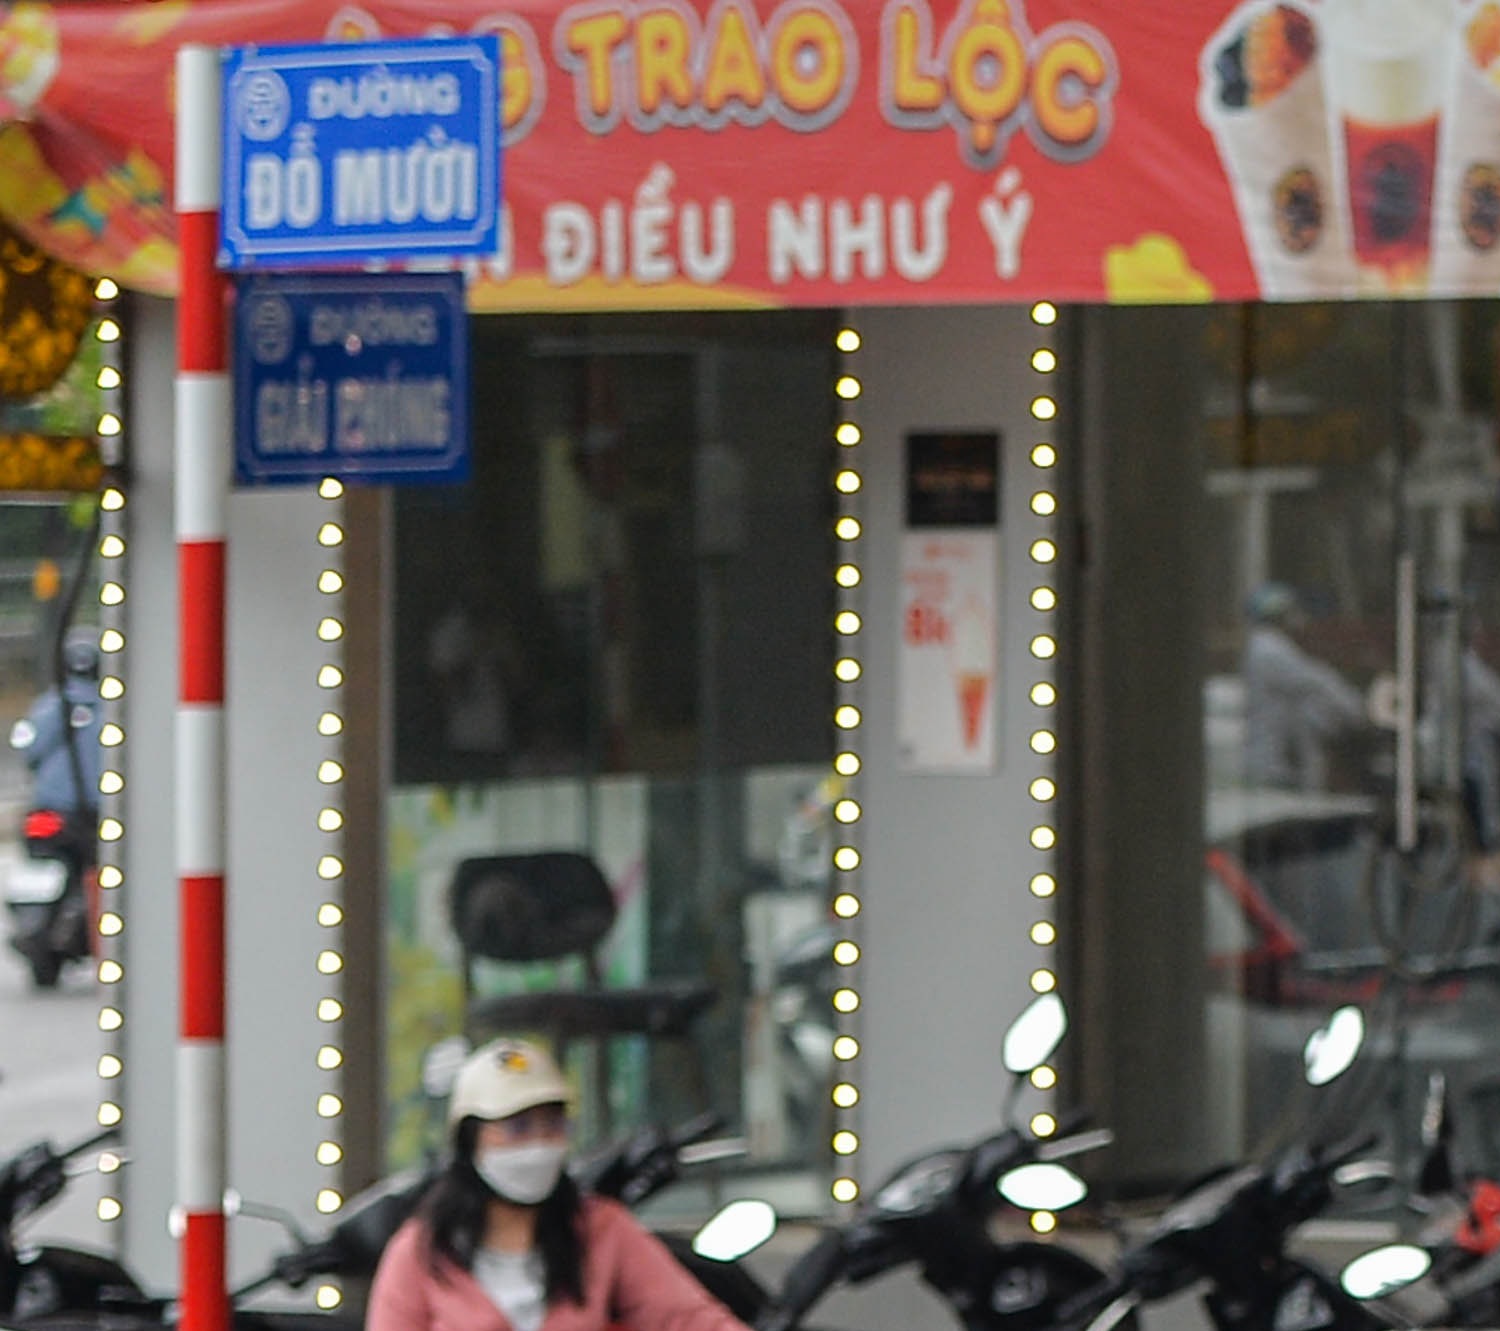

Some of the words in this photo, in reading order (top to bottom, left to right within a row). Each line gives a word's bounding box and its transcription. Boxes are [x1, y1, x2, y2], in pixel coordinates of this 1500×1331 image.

[558, 0, 854, 131] TRAO
[884, 0, 1116, 166] LỘC
[334, 124, 478, 228] MƯỜI
[767, 180, 956, 285] NHƯ
[978, 165, 1036, 282] Ý
